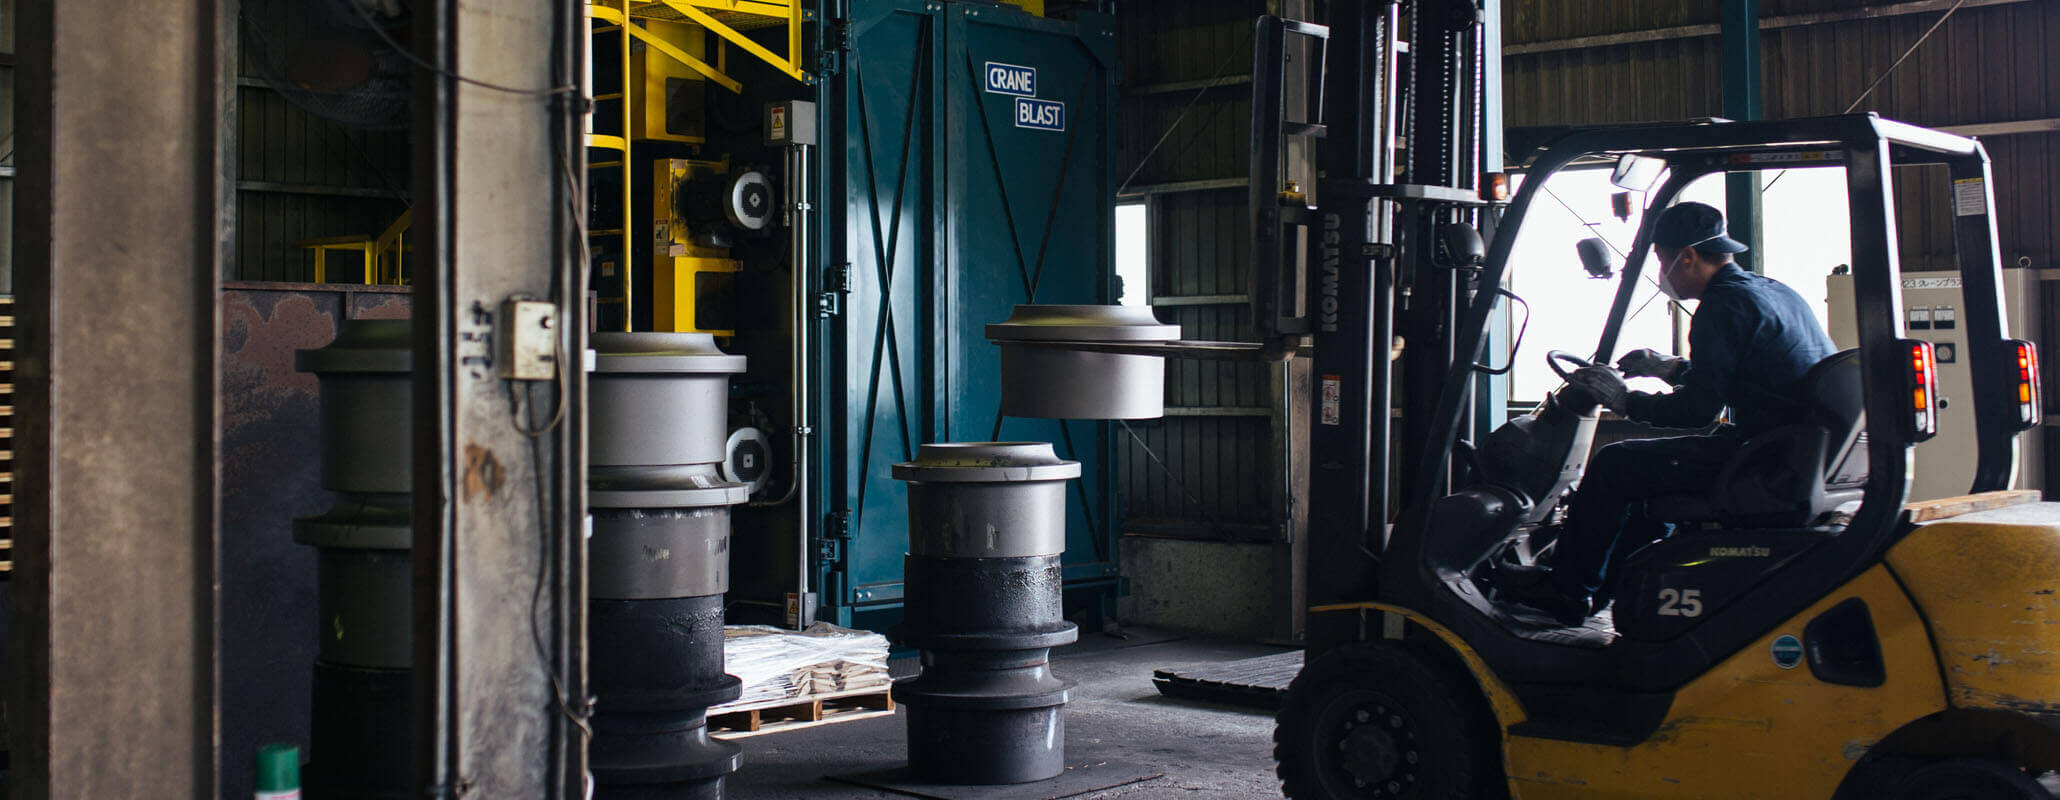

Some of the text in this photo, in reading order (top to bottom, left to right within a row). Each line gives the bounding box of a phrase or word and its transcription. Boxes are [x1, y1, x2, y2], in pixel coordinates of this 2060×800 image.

[990, 68, 1032, 92] CRANE
[1020, 102, 1060, 126] BLAST
[1321, 213, 1341, 332] KOMATSU
[1710, 546, 1770, 557] KOMATSU
[1657, 588, 1703, 618] 25
